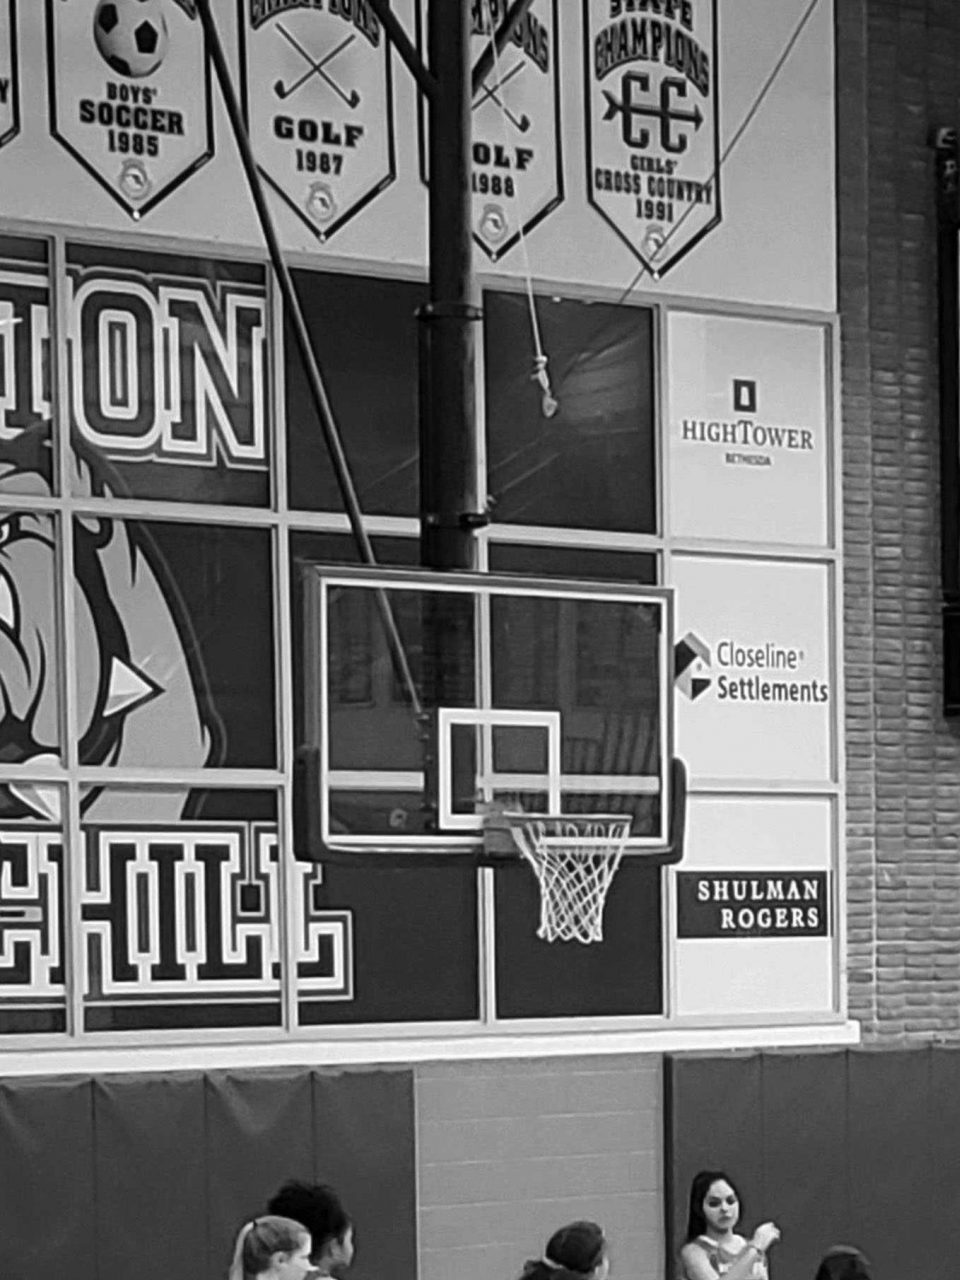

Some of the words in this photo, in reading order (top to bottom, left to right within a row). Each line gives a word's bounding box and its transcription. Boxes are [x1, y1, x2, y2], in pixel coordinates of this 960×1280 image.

[595, 17, 709, 98] CHAMPIONS
[106, 82, 157, 105] BOYS'
[79, 99, 184, 136] SOCCER
[107, 130, 159, 157] 1985
[273, 115, 364, 148] GOLF
[295, 149, 343, 175] 1987
[472, 143, 534, 170] OLF
[472, 172, 515, 198] 1988
[595, 168, 641, 195] CROSS
[647, 174, 713, 205] COUNTRY
[635, 199, 674, 223] 1991
[717, 641, 798, 669] Closeline
[717, 675, 828, 702] Settlements
[698, 880, 819, 901] SHULMAN
[720, 908, 819, 928] ROGERS
